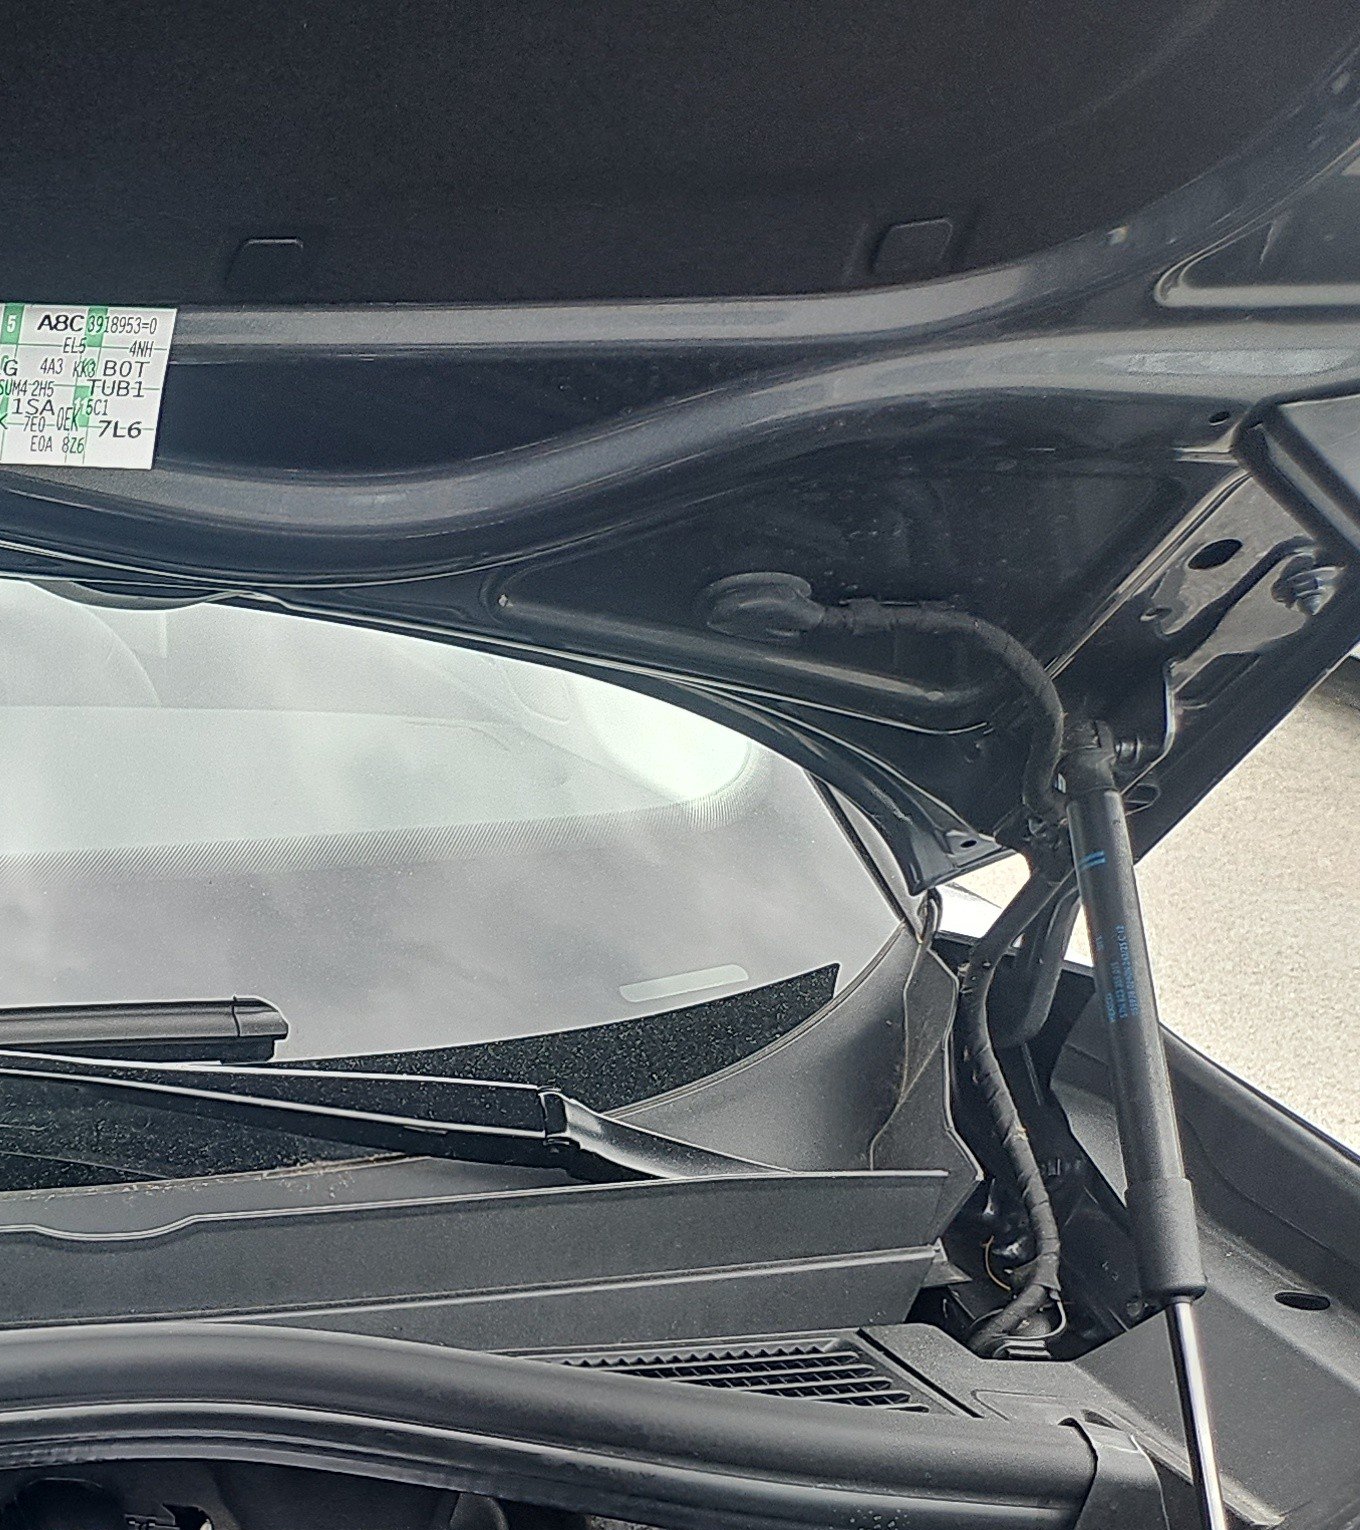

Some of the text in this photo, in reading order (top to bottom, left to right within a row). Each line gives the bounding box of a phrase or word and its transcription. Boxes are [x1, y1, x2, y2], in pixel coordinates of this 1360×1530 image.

[6, 314, 16, 332] 5
[87, 315, 158, 334] 3918953=0
[63, 337, 86, 354] EL5
[130, 340, 154, 358] 4NH
[40, 358, 63, 374] 4A3
[31, 380, 54, 397] 2H5
[89, 380, 146, 398] TUB1
[12, 399, 55, 416] 1SA
[98, 421, 142, 438] 7L6
[62, 436, 85, 453] 8Z6
